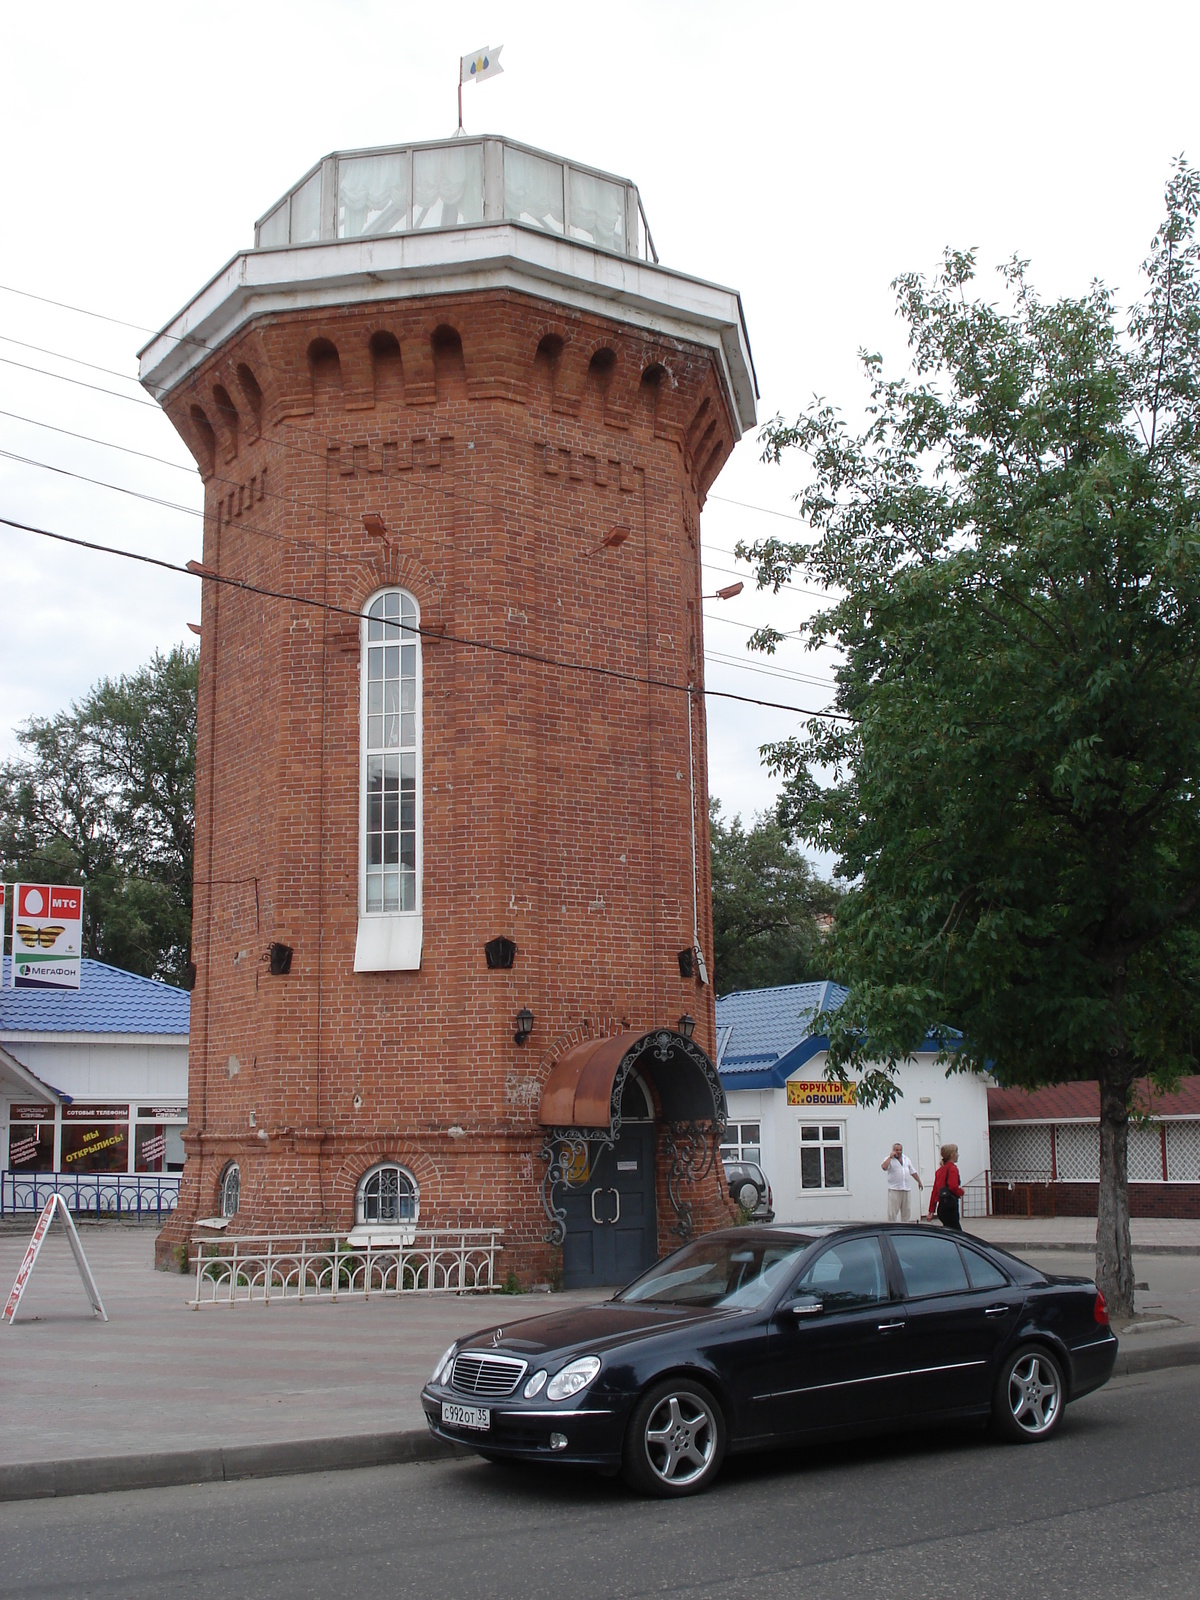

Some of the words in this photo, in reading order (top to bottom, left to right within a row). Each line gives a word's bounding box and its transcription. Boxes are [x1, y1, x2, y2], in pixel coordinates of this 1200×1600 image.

[52, 899, 77, 909] МТС
[800, 1083, 843, 1092] ФРУКТЫ
[806, 1095, 843, 1104] ОВОЩИ
[83, 1130, 100, 1142] МЫ
[66, 1133, 124, 1162] ОТКРЫЛИСЬ!
[477, 1408, 487, 1421] 35
